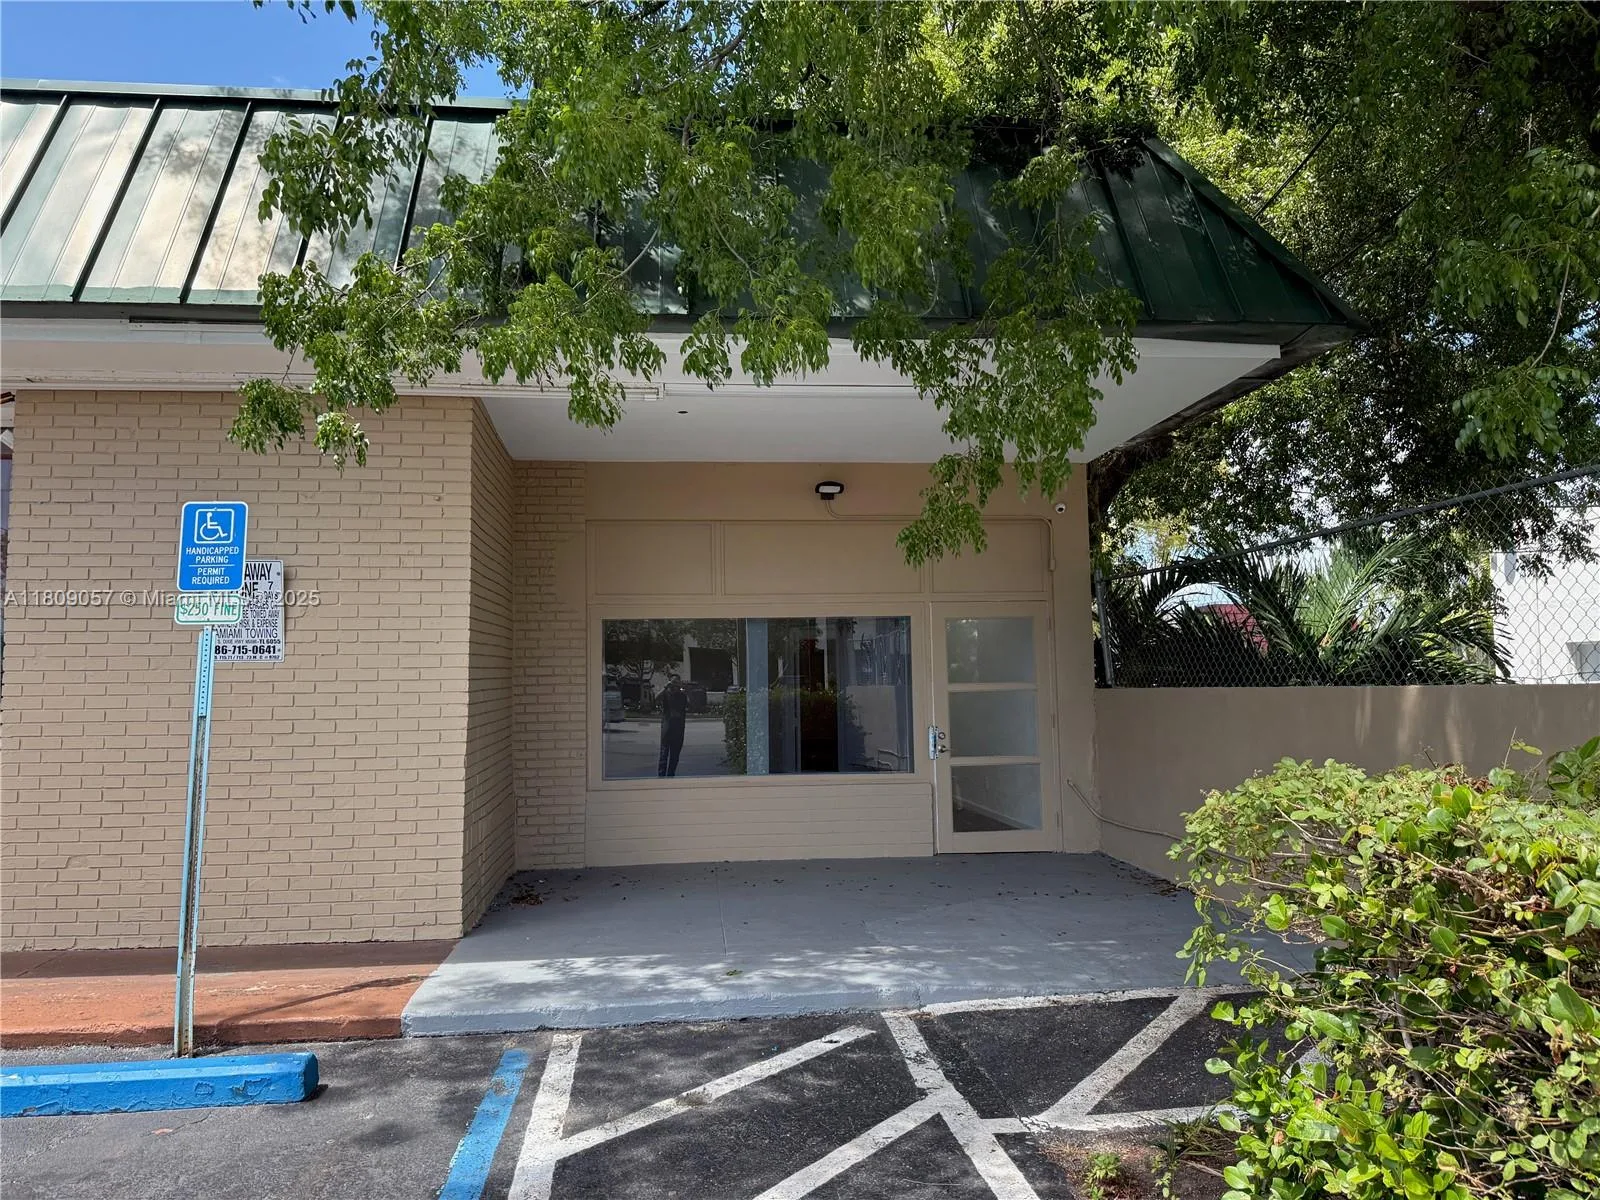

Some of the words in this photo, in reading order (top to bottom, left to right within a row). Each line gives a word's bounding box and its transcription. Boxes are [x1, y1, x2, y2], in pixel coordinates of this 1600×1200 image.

[185, 546, 240, 555] HANDICAPPED
[195, 555, 229, 564] PARKING
[197, 567, 225, 576] PERMIT
[191, 576, 230, 585] REQUIRED
[267, 581, 274, 591] 7
[180, 603, 209, 616] $250
[213, 602, 238, 616] FINE
[245, 628, 278, 639] TOWING
[214, 644, 277, 655] 86-715-0641
